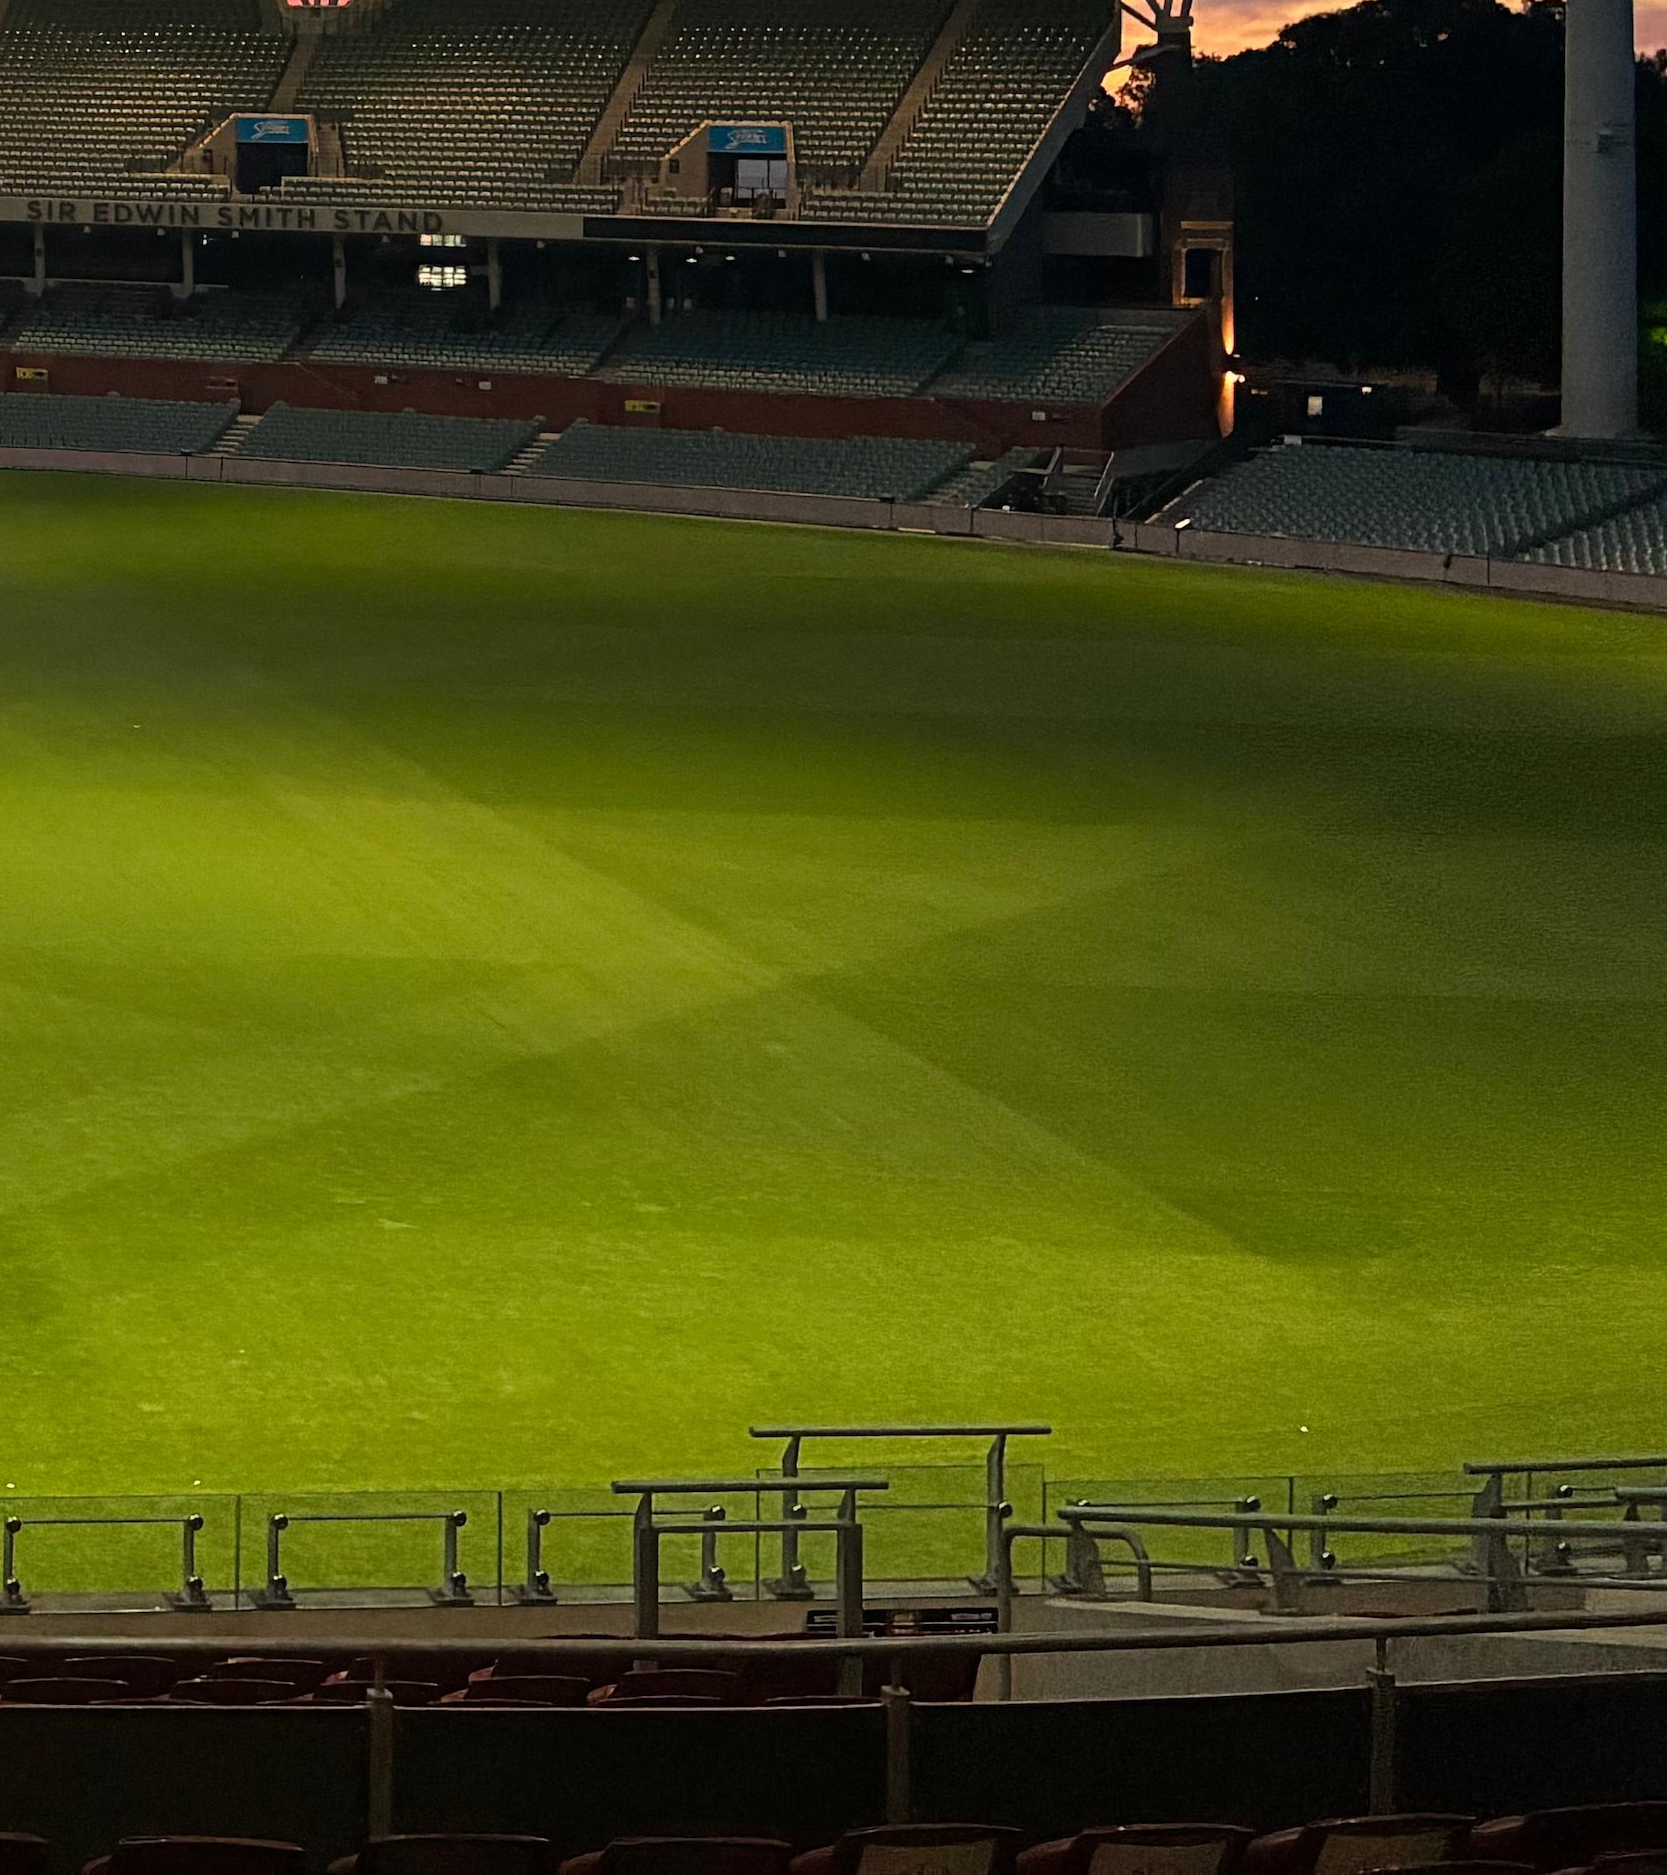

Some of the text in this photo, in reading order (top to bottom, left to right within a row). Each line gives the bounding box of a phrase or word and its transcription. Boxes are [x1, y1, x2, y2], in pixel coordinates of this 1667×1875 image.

[27, 199, 443, 232] SIR EDWIN SMITH STAND
